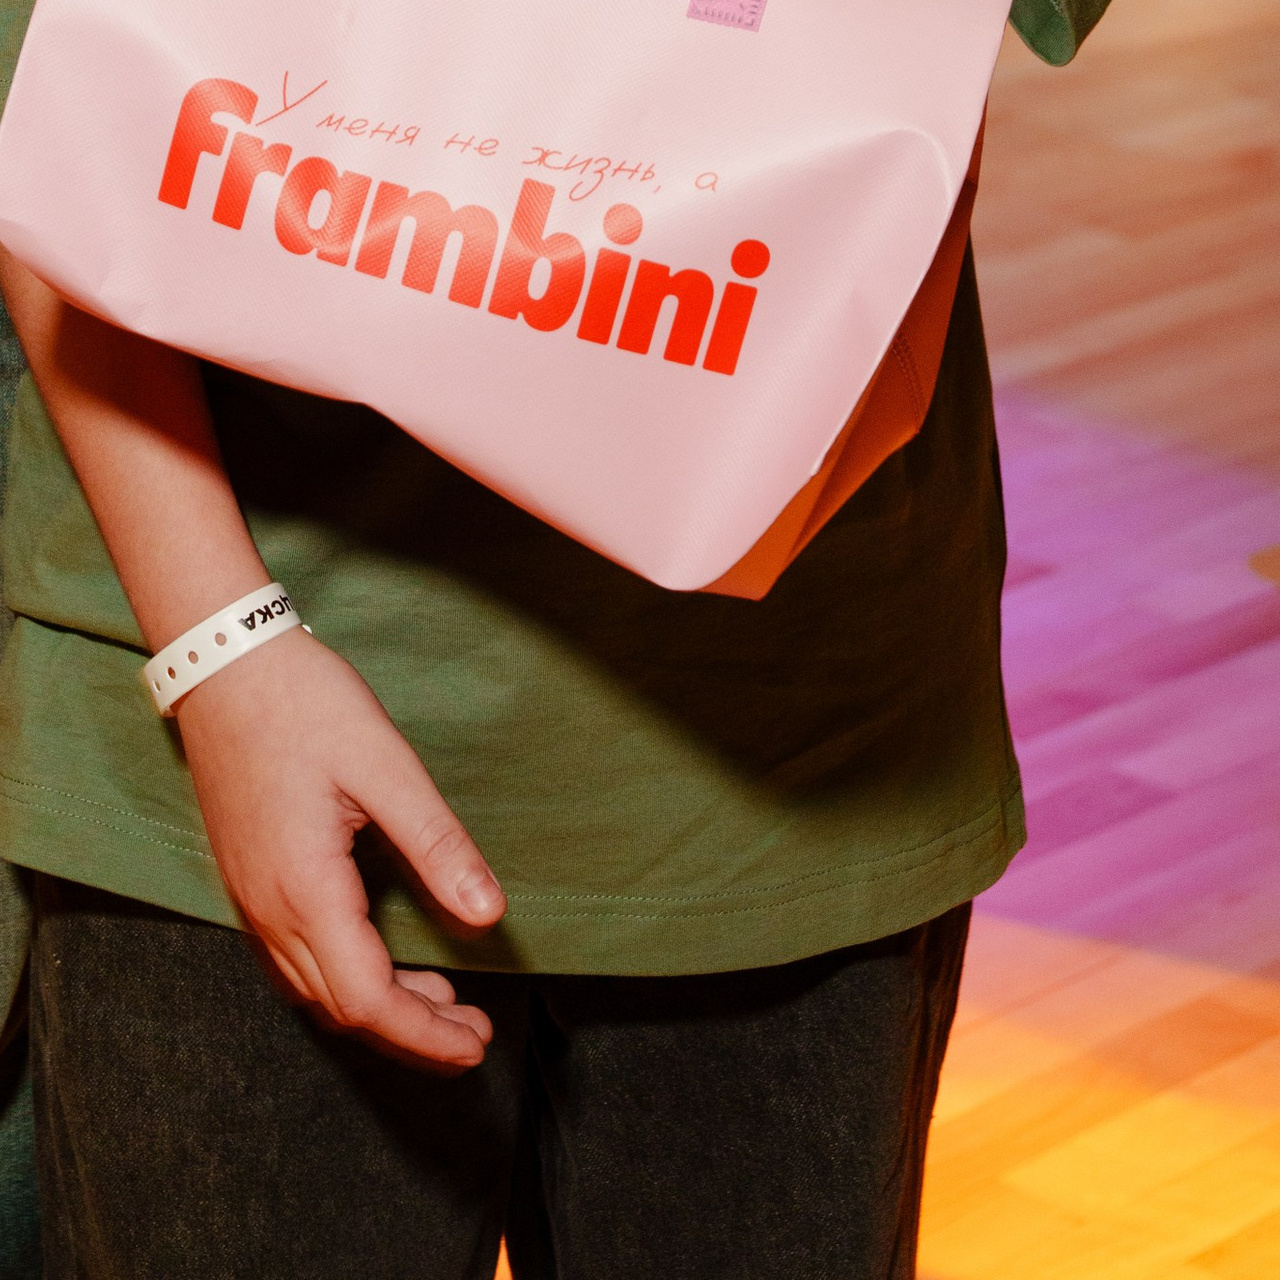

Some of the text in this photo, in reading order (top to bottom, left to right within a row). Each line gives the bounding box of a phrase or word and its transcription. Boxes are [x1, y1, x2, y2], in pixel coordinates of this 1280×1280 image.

[256, 70, 719, 202] У меня не жизнь, а
[157, 77, 771, 376] frambini
[238, 594, 295, 631] ЦСКА
